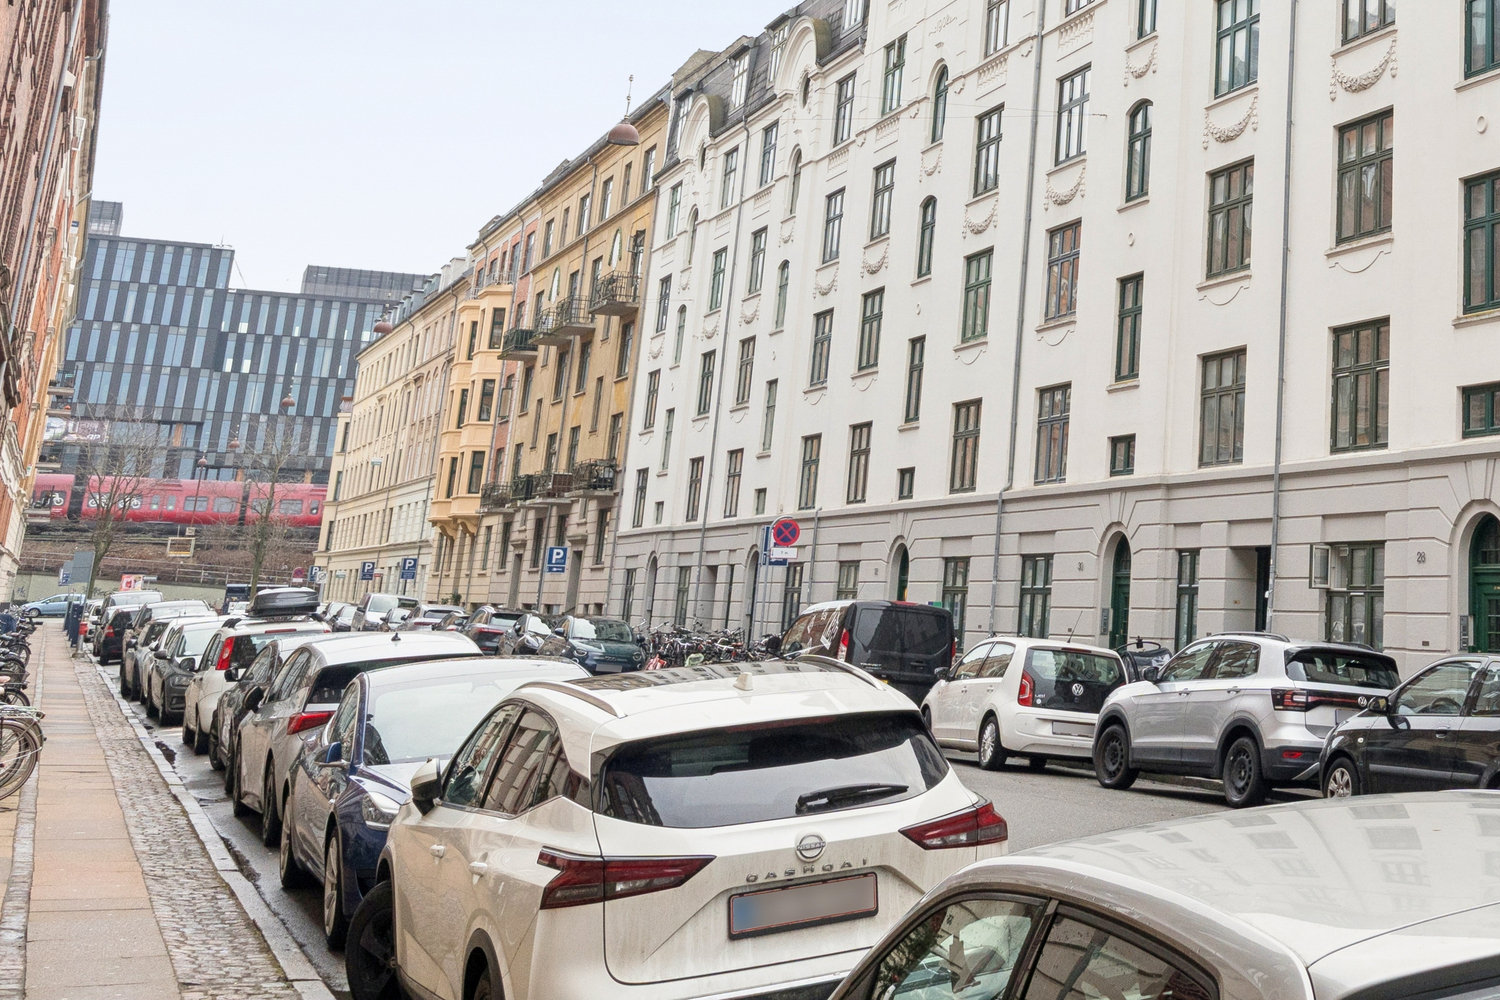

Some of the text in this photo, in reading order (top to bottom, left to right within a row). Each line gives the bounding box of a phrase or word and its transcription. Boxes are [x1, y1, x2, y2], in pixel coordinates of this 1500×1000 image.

[552, 548, 564, 564] P
[364, 563, 373, 573] P
[405, 559, 414, 570] P
[745, 858, 868, 883] QASHQAI
